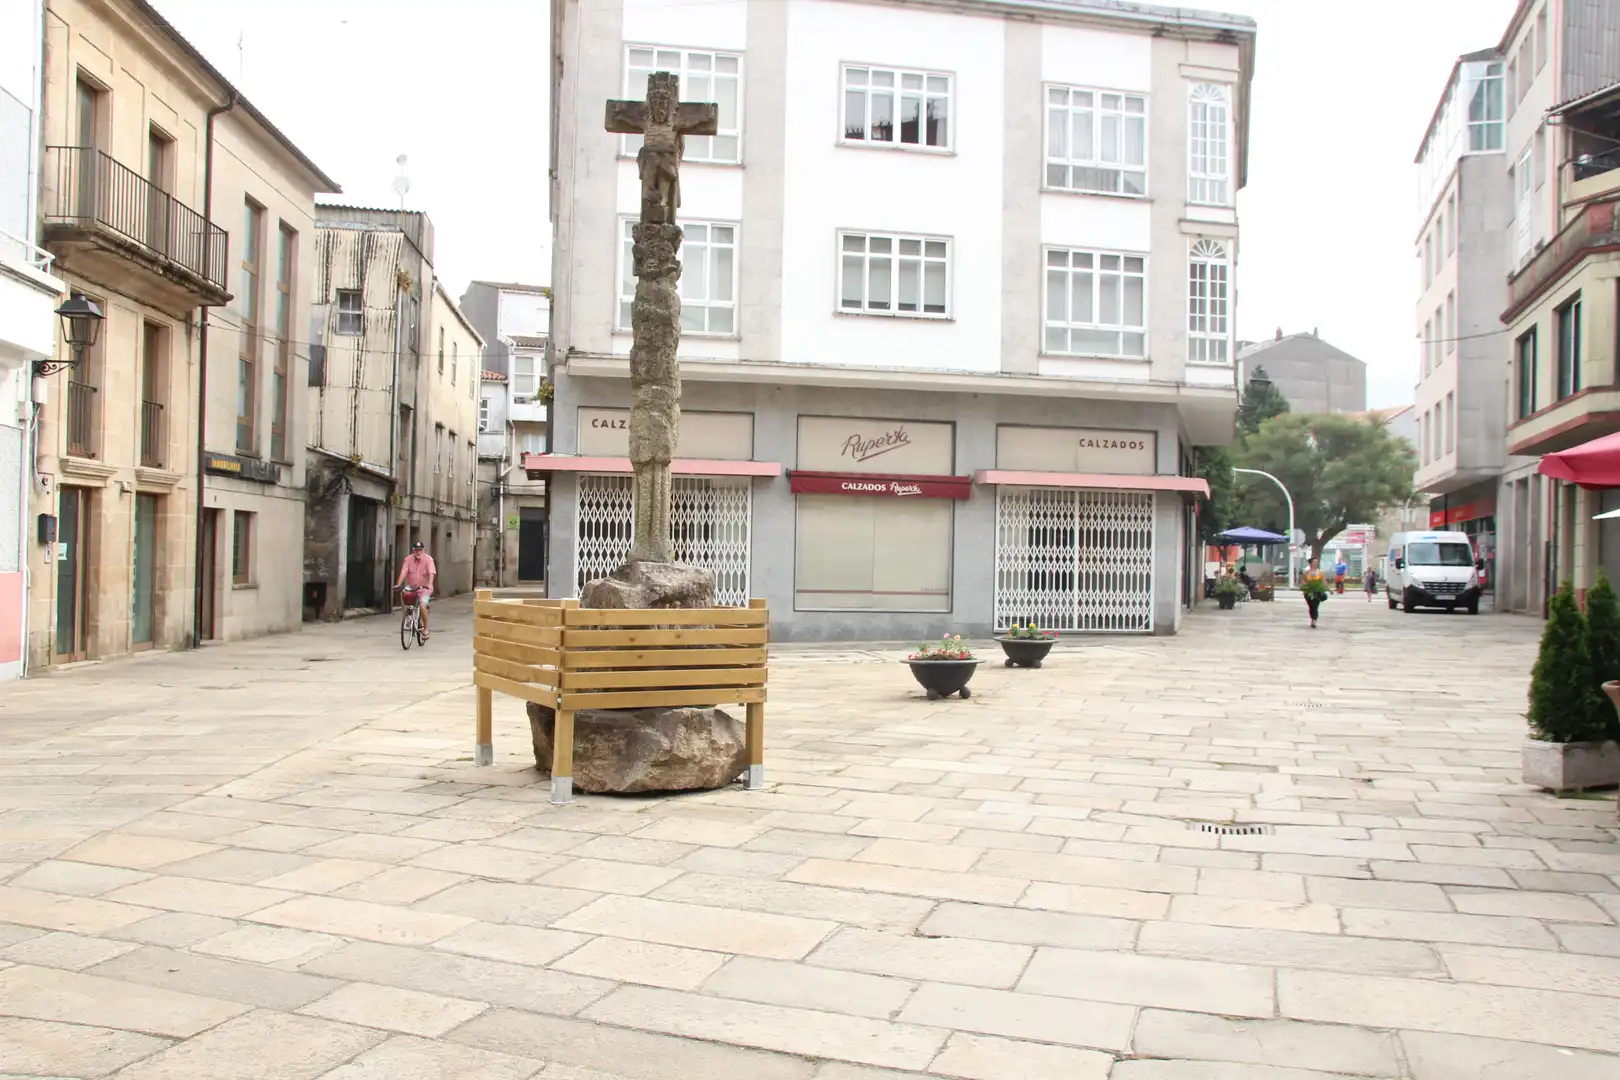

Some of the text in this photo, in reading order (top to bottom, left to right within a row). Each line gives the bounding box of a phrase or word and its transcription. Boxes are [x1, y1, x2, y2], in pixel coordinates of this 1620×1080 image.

[840, 425, 911, 462] Ruperta
[1079, 438, 1144, 450] CALZADOS
[841, 482, 887, 491] CALZADOS
